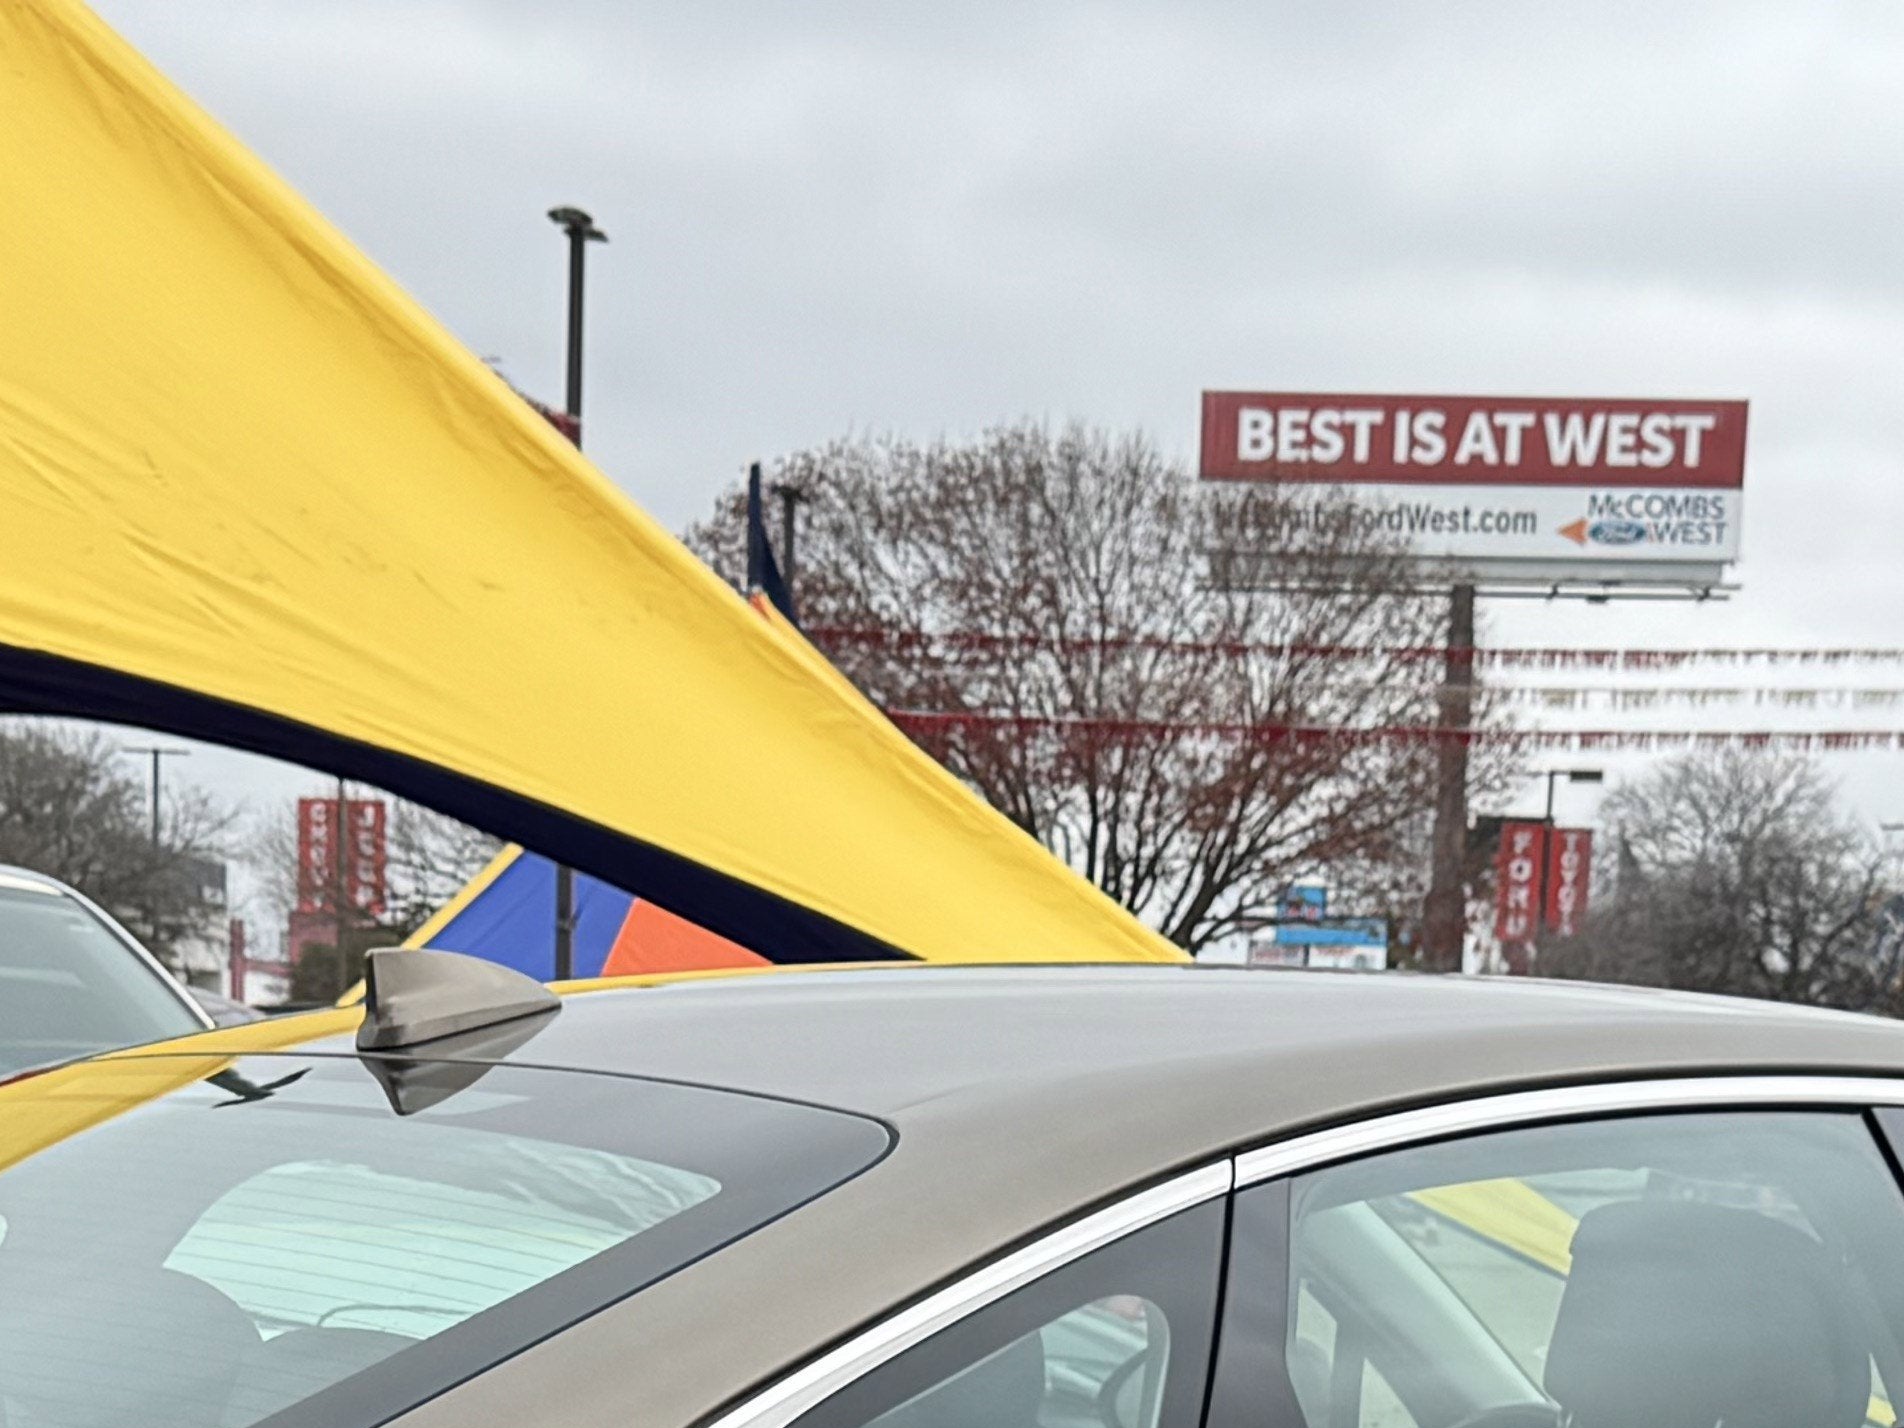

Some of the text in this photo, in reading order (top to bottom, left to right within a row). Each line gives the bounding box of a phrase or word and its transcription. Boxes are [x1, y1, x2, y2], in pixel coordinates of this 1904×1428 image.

[1237, 408, 1717, 469] BEST IS AT WEST
[1652, 521, 1728, 545] WEST
